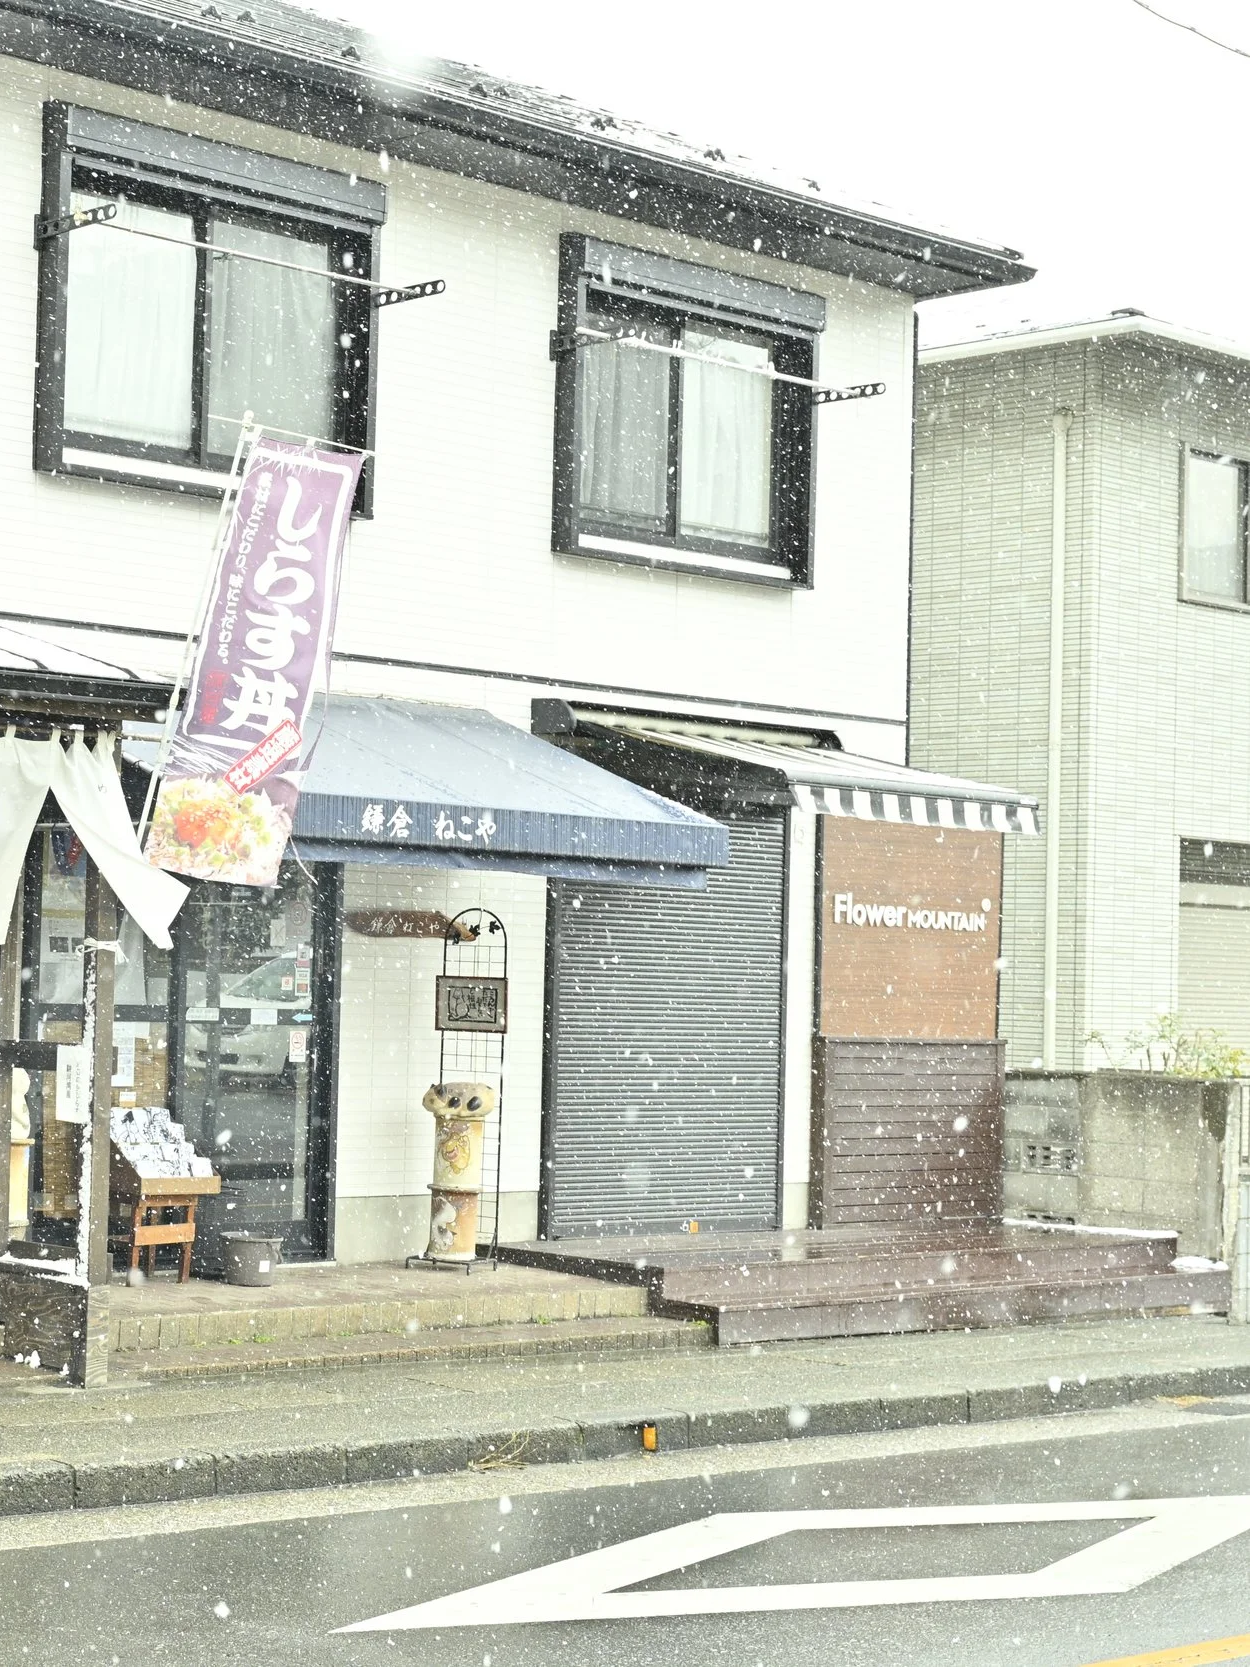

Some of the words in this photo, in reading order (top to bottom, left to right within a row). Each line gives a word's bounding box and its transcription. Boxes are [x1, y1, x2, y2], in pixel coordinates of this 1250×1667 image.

[217, 475, 324, 738] しらす丼
[361, 803, 413, 838] 鎌倉
[434, 810, 497, 847] ねこや
[834, 893, 906, 927] Flower
[907, 910, 986, 932] MOUNTAIN
